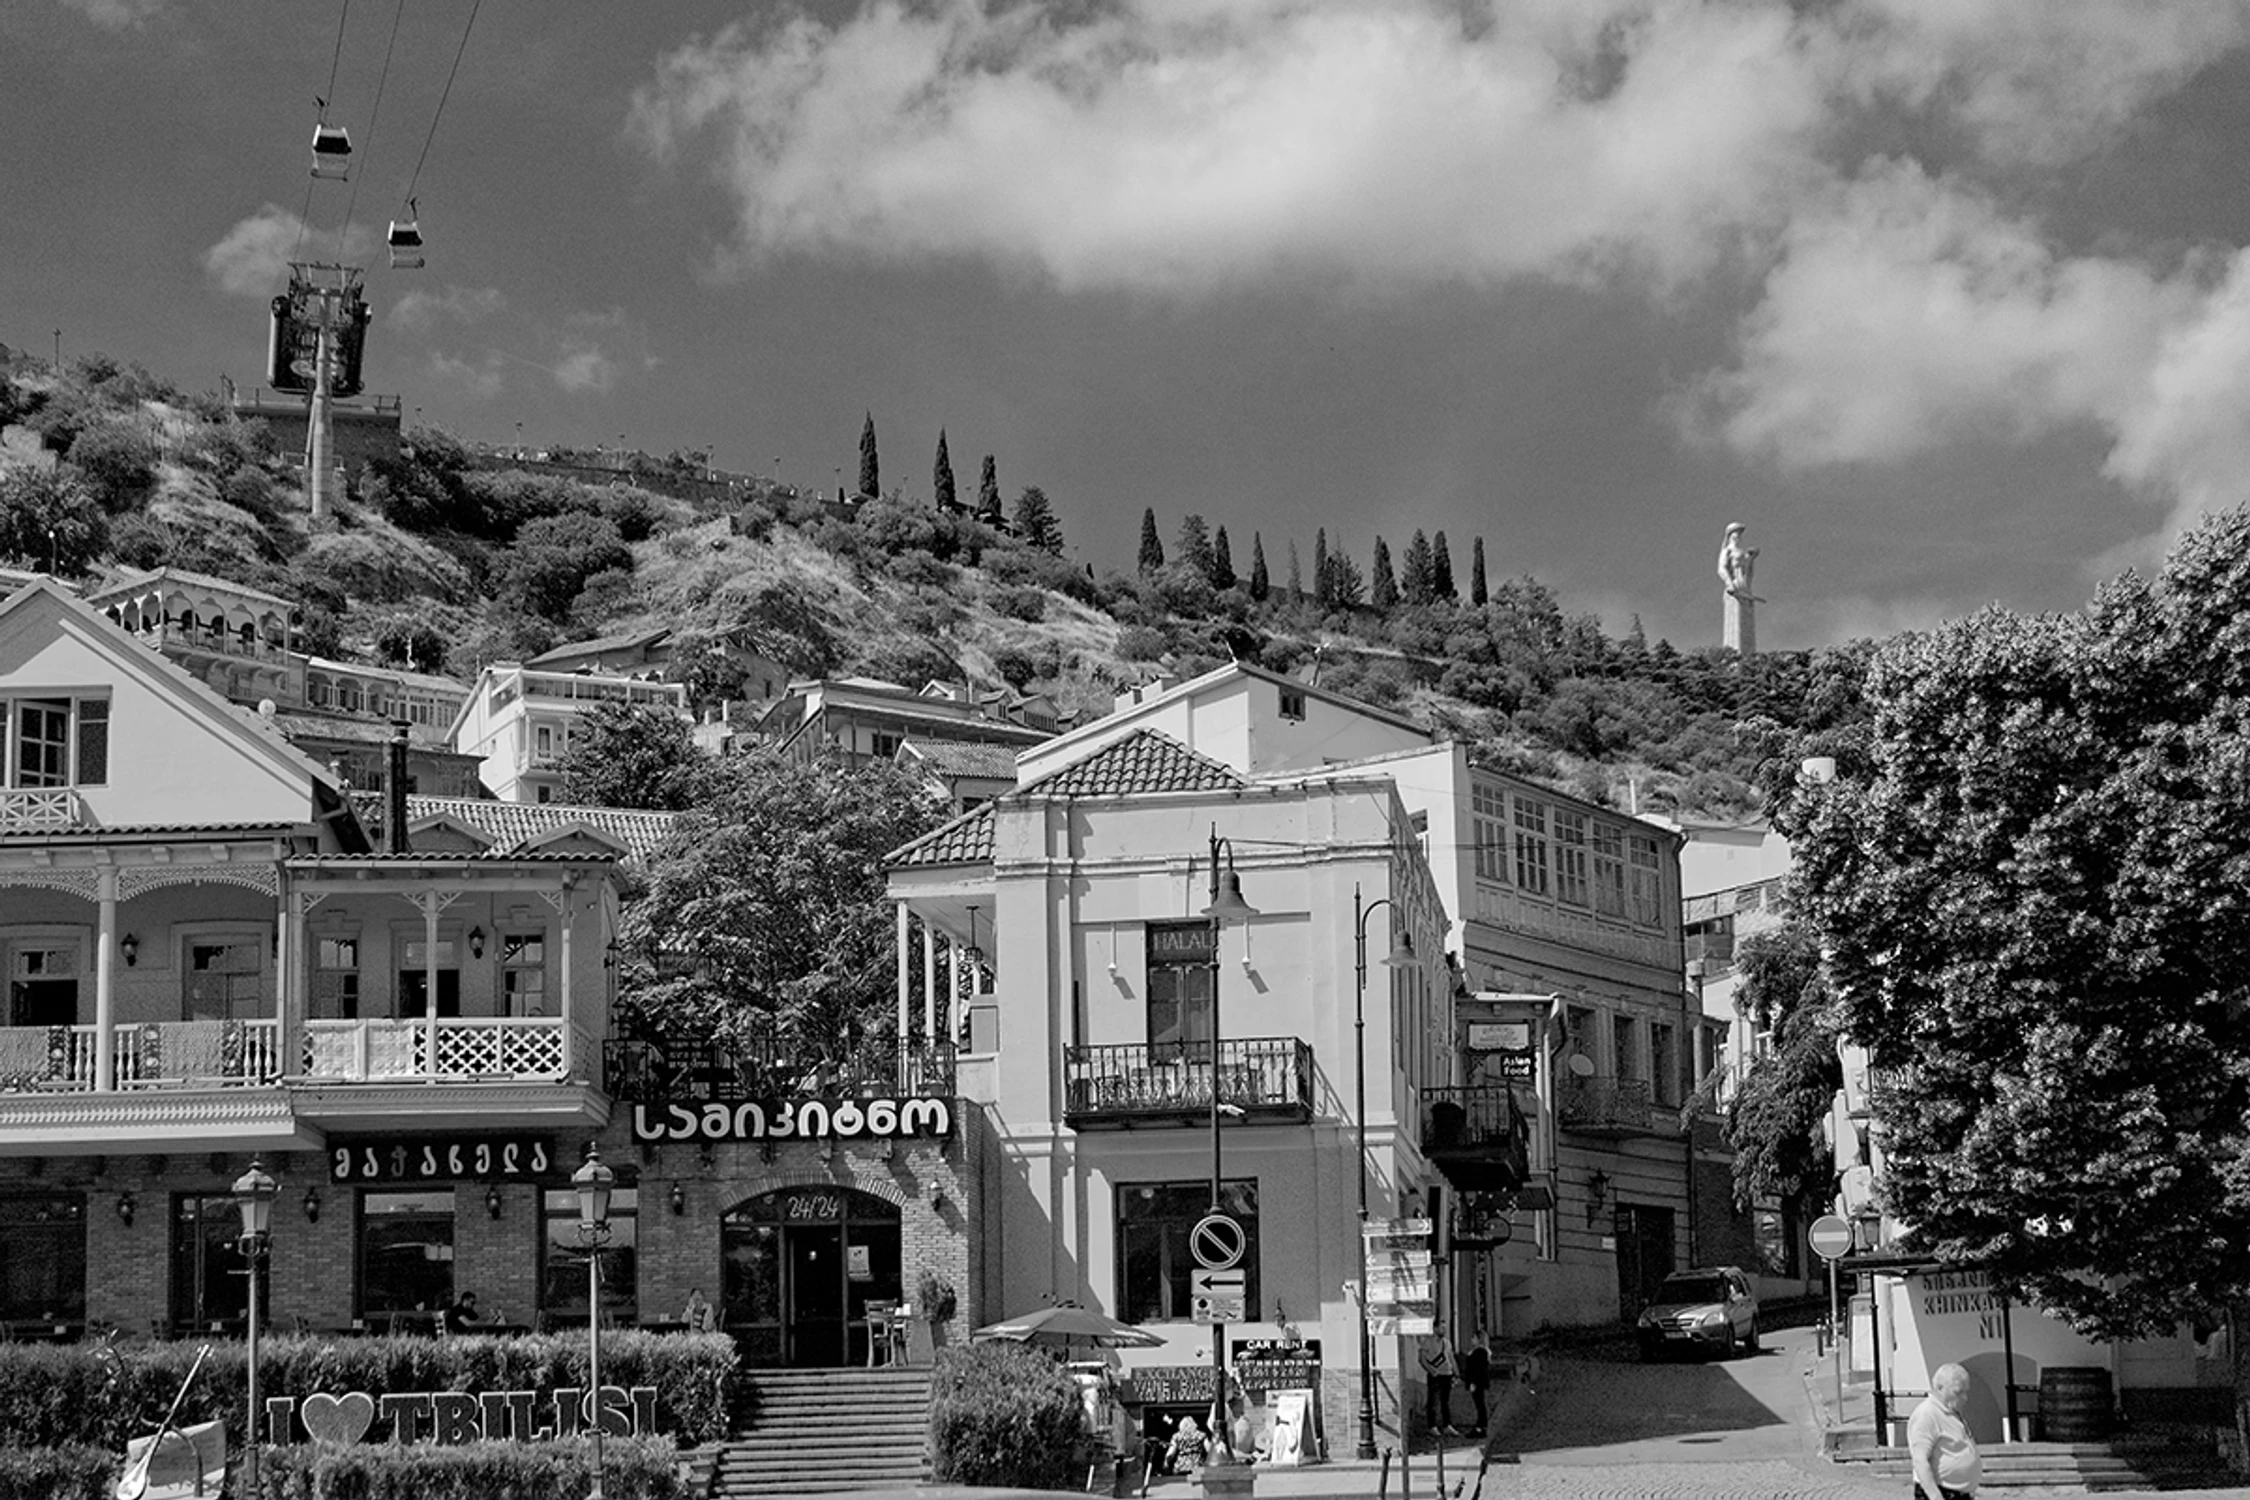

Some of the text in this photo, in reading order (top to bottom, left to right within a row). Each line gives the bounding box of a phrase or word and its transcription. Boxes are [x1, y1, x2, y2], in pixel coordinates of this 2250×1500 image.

[634, 1098, 949, 1140] სამიკიტნო
[335, 1142, 548, 1179] მაჭახელა
[788, 1196, 840, 1219] 24/24
[1246, 1340, 1308, 1350] CAR RENT
[266, 1385, 658, 1446] I TBILISI
